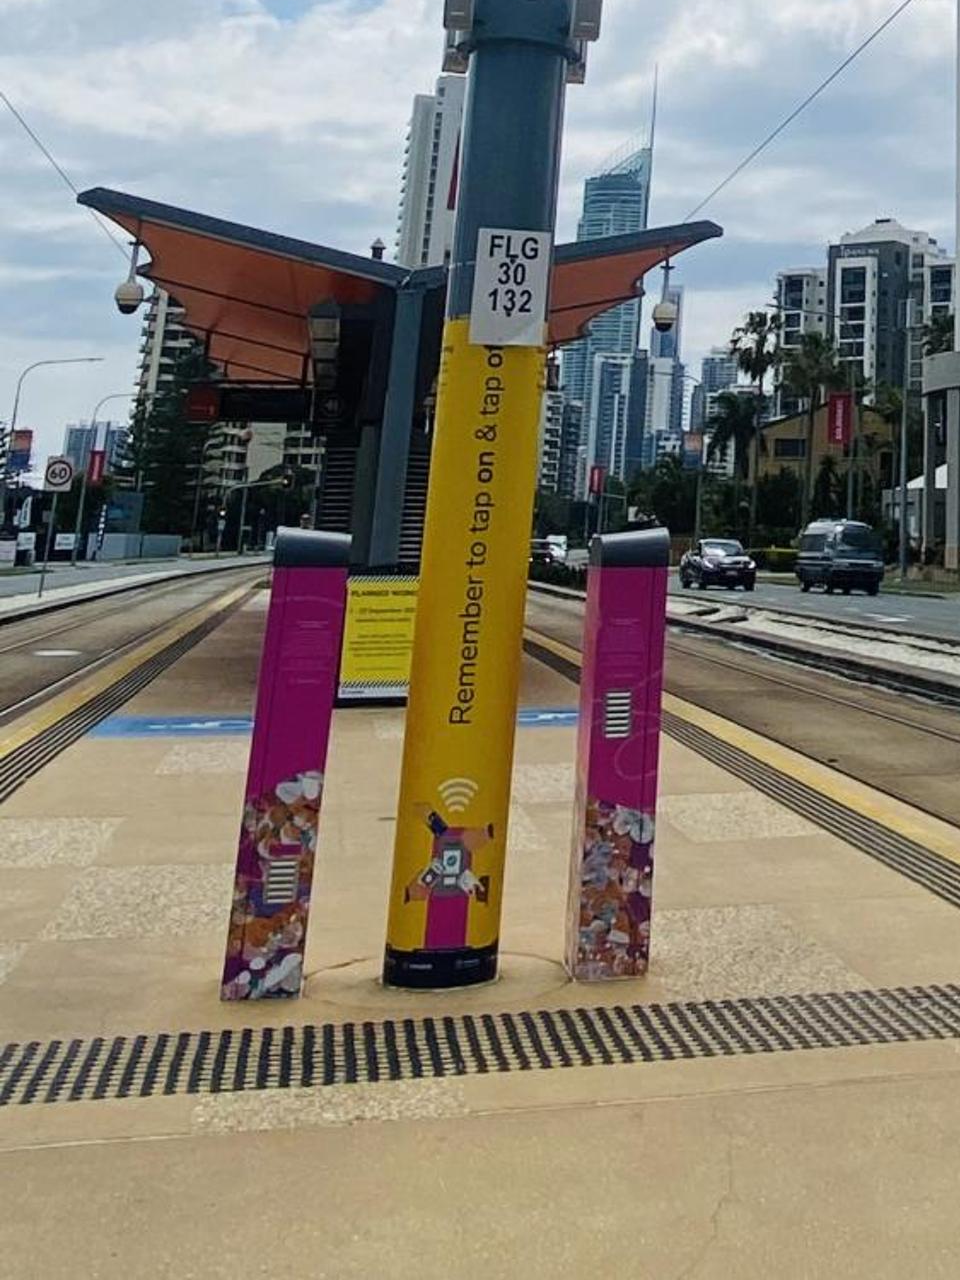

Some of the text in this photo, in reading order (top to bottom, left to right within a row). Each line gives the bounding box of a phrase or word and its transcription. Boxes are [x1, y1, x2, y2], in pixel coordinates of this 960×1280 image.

[489, 235, 539, 260] FLG
[498, 262, 526, 286] 30
[488, 288, 532, 313] 132
[480, 376, 505, 416] tap
[475, 424, 497, 442] &
[50, 467, 68, 479] 60
[477, 451, 496, 483] on
[469, 492, 495, 532] tap
[466, 541, 487, 568] to
[449, 575, 484, 725] Remember
